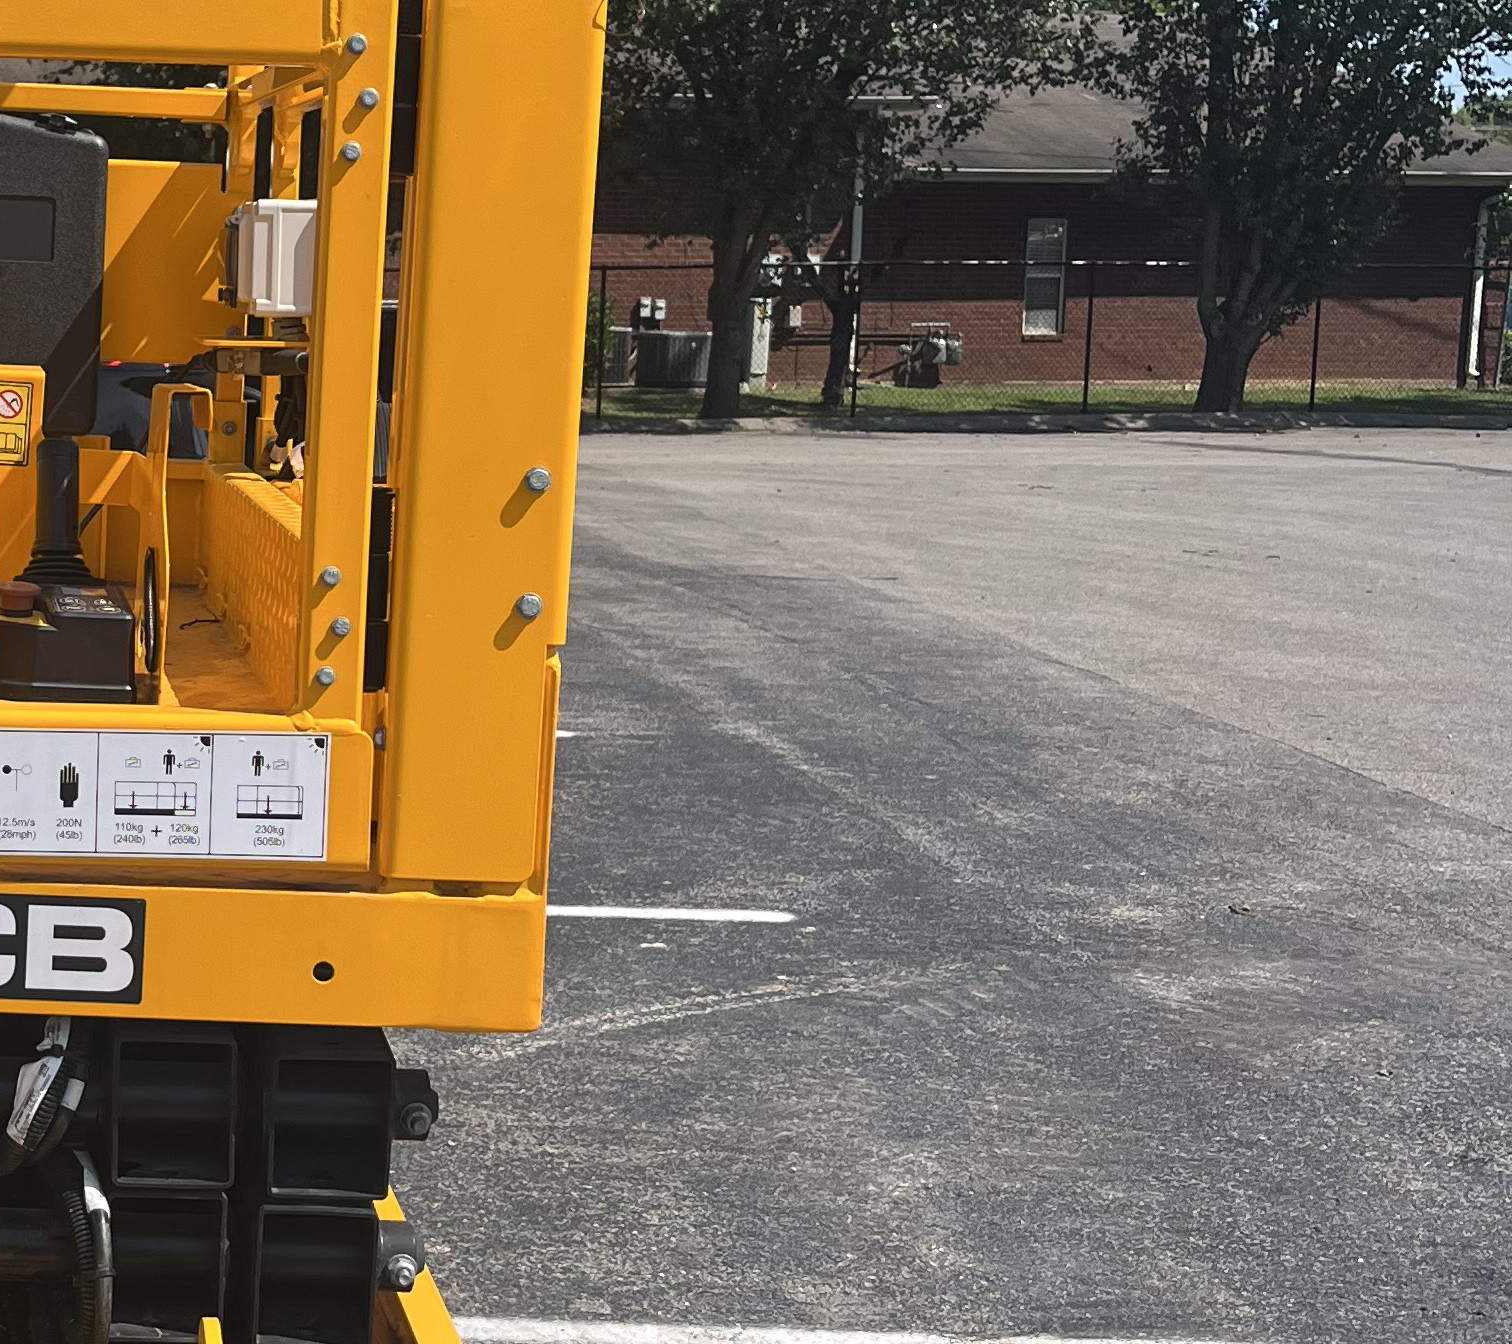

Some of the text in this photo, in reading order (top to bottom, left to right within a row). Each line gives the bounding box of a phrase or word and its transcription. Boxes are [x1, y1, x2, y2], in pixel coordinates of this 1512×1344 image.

[55, 818, 82, 827] 200N
[115, 822, 144, 833] 110kg
[170, 823, 199, 835] 120kg
[254, 824, 285, 836] 230kg
[55, 830, 83, 841] (45lb)
